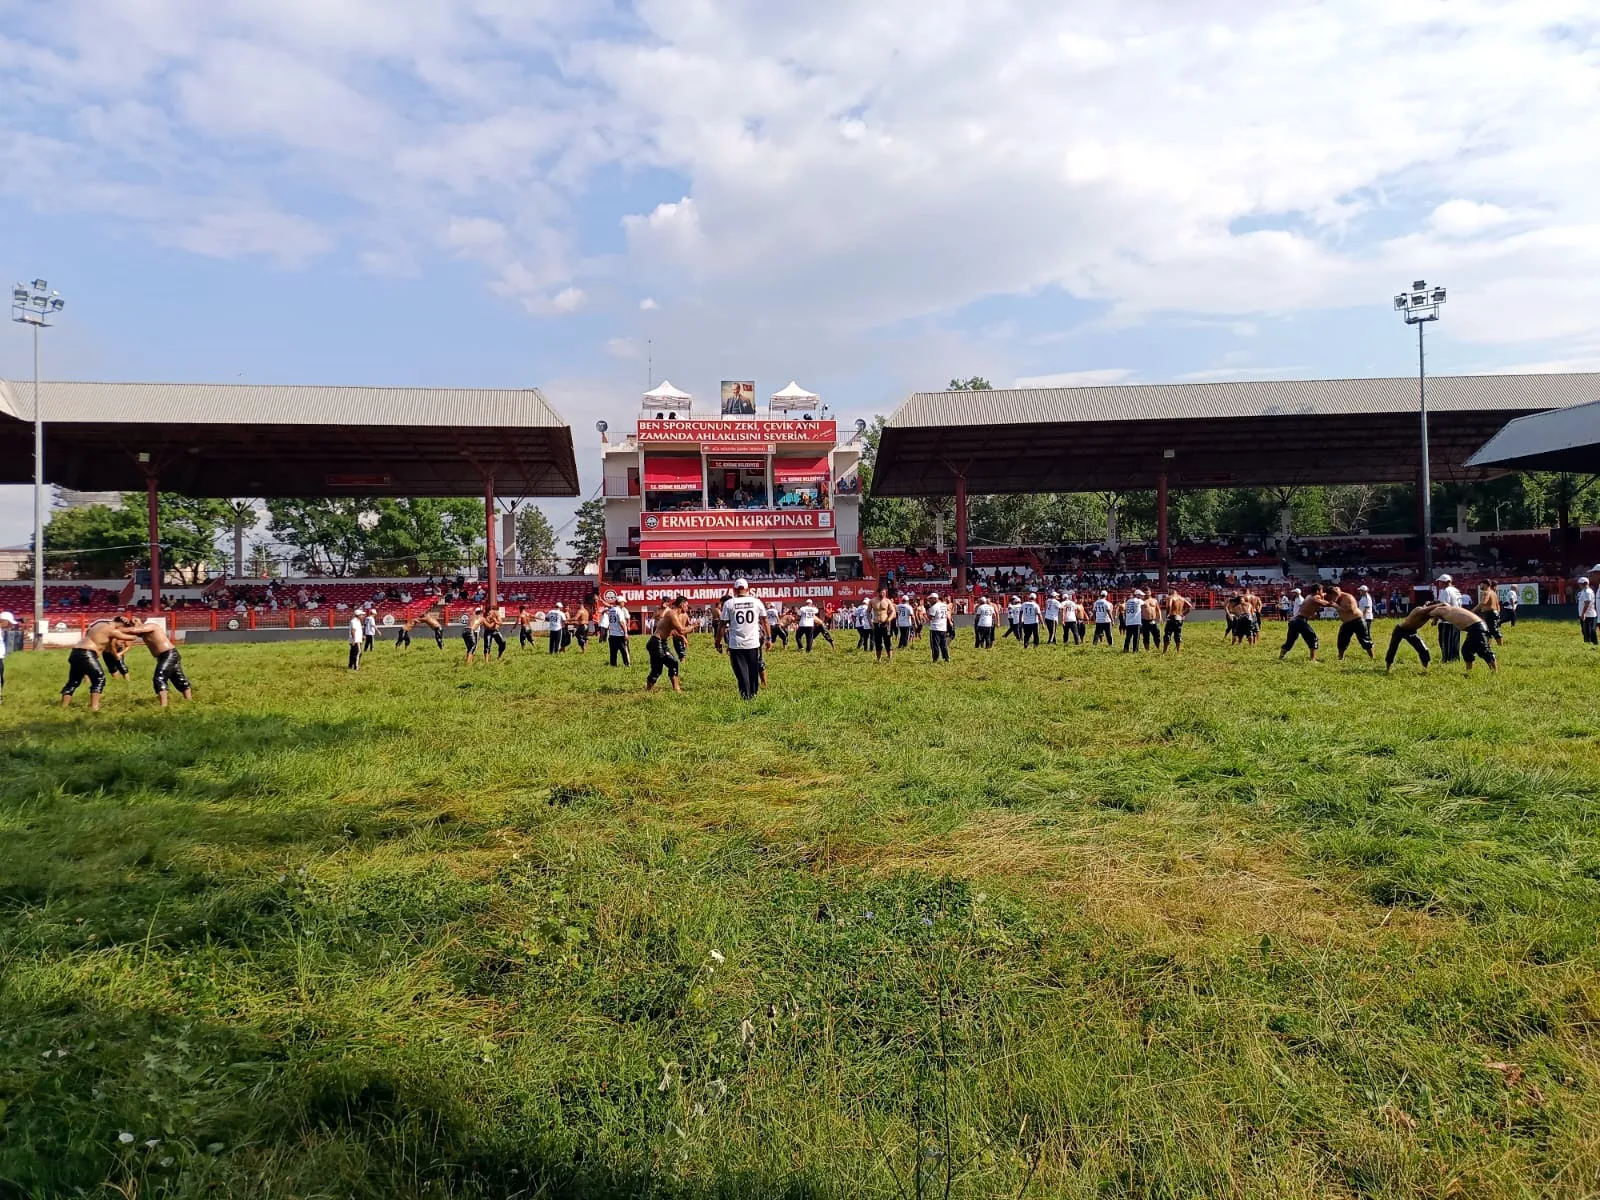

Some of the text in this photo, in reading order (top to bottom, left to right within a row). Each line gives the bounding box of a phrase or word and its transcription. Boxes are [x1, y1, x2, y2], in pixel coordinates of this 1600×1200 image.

[639, 421, 660, 430] BEN
[663, 421, 732, 430] SPORCUNUN
[763, 421, 795, 432] ÇEVİK
[795, 421, 820, 430] AYNI
[639, 432, 694, 440] ZAMANDA
[696, 432, 761, 441] AHLAKLISINI
[662, 514, 813, 528] ERMEYDANI KIRKPINAR
[792, 586, 834, 597] DİLERİM
[735, 610, 754, 625] 60
